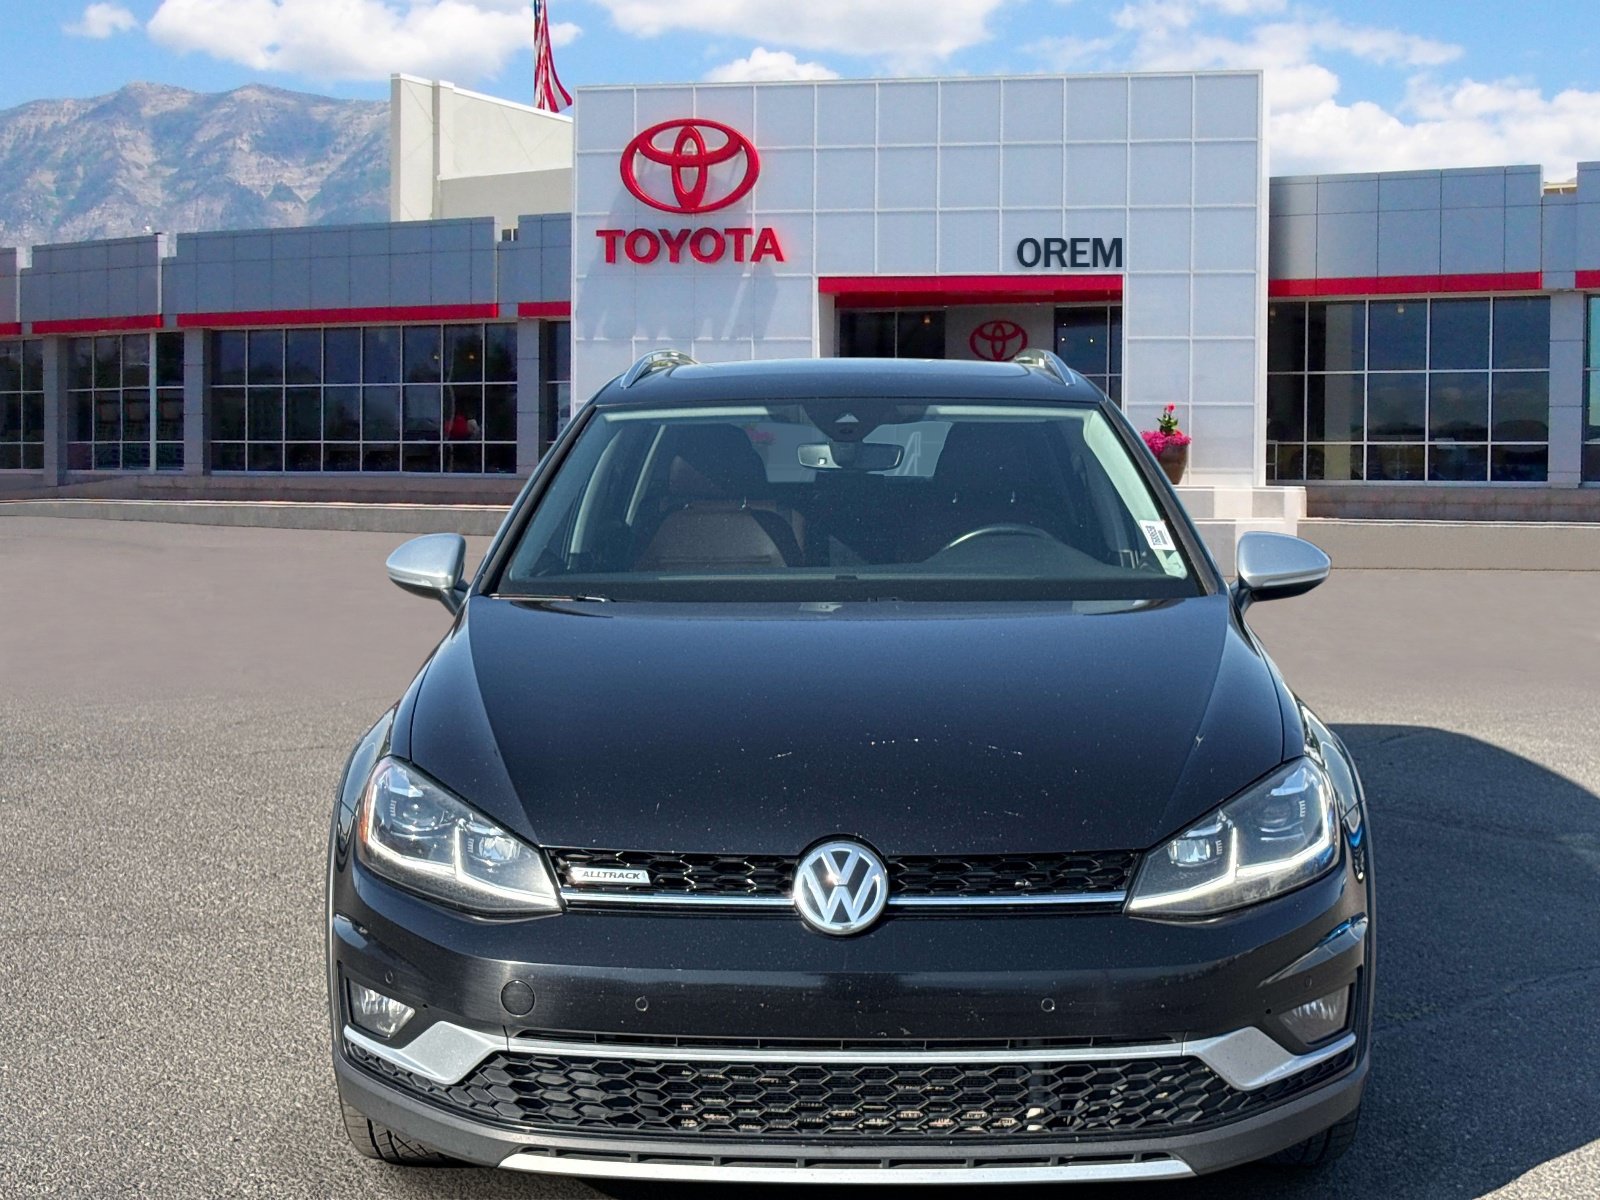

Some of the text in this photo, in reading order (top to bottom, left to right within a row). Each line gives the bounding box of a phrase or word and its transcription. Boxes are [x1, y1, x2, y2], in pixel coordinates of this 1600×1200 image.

[596, 227, 785, 264] TOYOTA
[1017, 237, 1123, 268] OREM
[582, 870, 641, 880] ALLTRACK
[796, 844, 886, 929] VW
